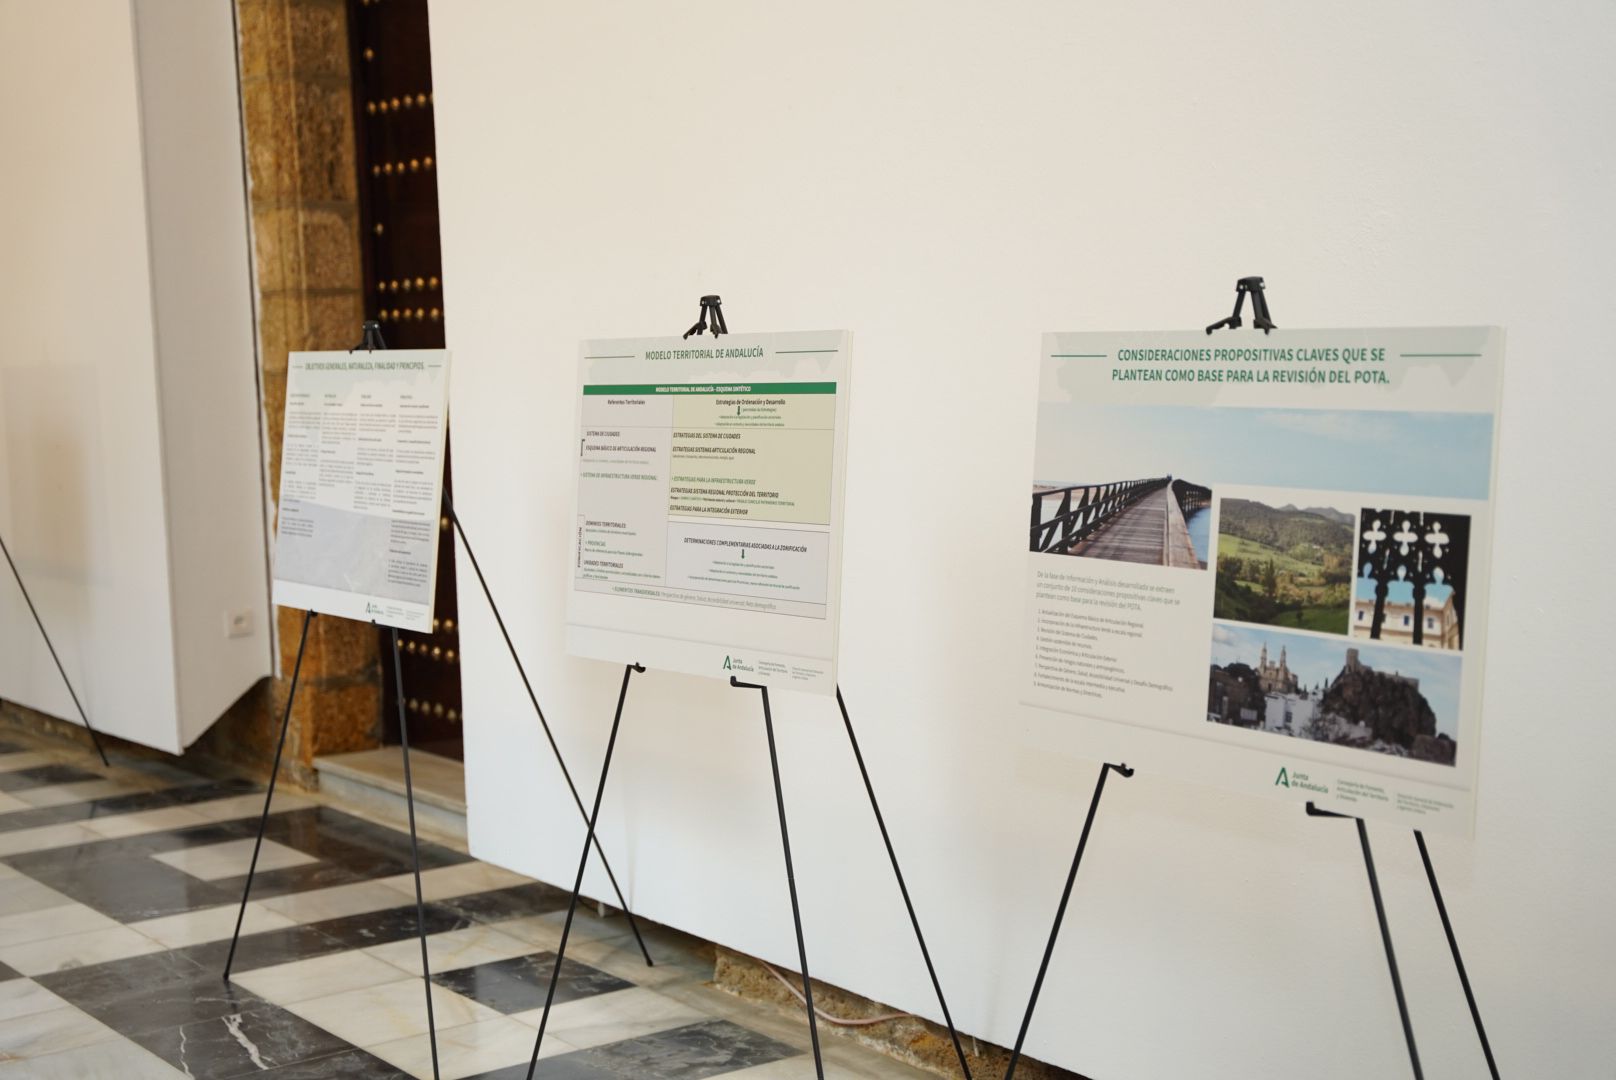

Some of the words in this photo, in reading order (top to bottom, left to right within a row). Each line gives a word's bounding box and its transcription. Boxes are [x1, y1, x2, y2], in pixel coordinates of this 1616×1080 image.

[645, 350, 671, 360] MODELO
[672, 349, 714, 359] TERRITORIAL
[714, 349, 724, 358] DE
[724, 346, 763, 358] ANDALUCÍA
[1117, 348, 1212, 361] CONSIDERACIONES
[1213, 348, 1294, 361] PROPOSITIVAS
[1294, 348, 1339, 361] CLAVES
[1340, 348, 1368, 364] QUE
[1369, 348, 1385, 362] SE
[1111, 369, 1162, 381] PLANTEAN
[1163, 370, 1195, 381] COMO
[1196, 370, 1224, 381] BASE
[1225, 370, 1255, 382] PARA
[1255, 370, 1270, 382] LA
[1271, 368, 1326, 383] REVISIÓN
[1327, 371, 1351, 383] DEL
[1352, 371, 1389, 383] POTA.
[711, 446, 737, 454] ARTICULACIÓN
[725, 488, 748, 496] PROTECCIÓN
[706, 506, 730, 514] INTEGRACIÓN
[683, 537, 716, 545] DETERMINACIONES
[716, 540, 750, 548] COMPLEMENTARIAS
[750, 542, 771, 550] ASOCIADAS
[779, 543, 807, 553] ZONIFICACIÓN
[599, 560, 623, 568] TERRITORIALES
[1292, 772, 1308, 780] Junta
[1299, 781, 1328, 792] Andalucía
